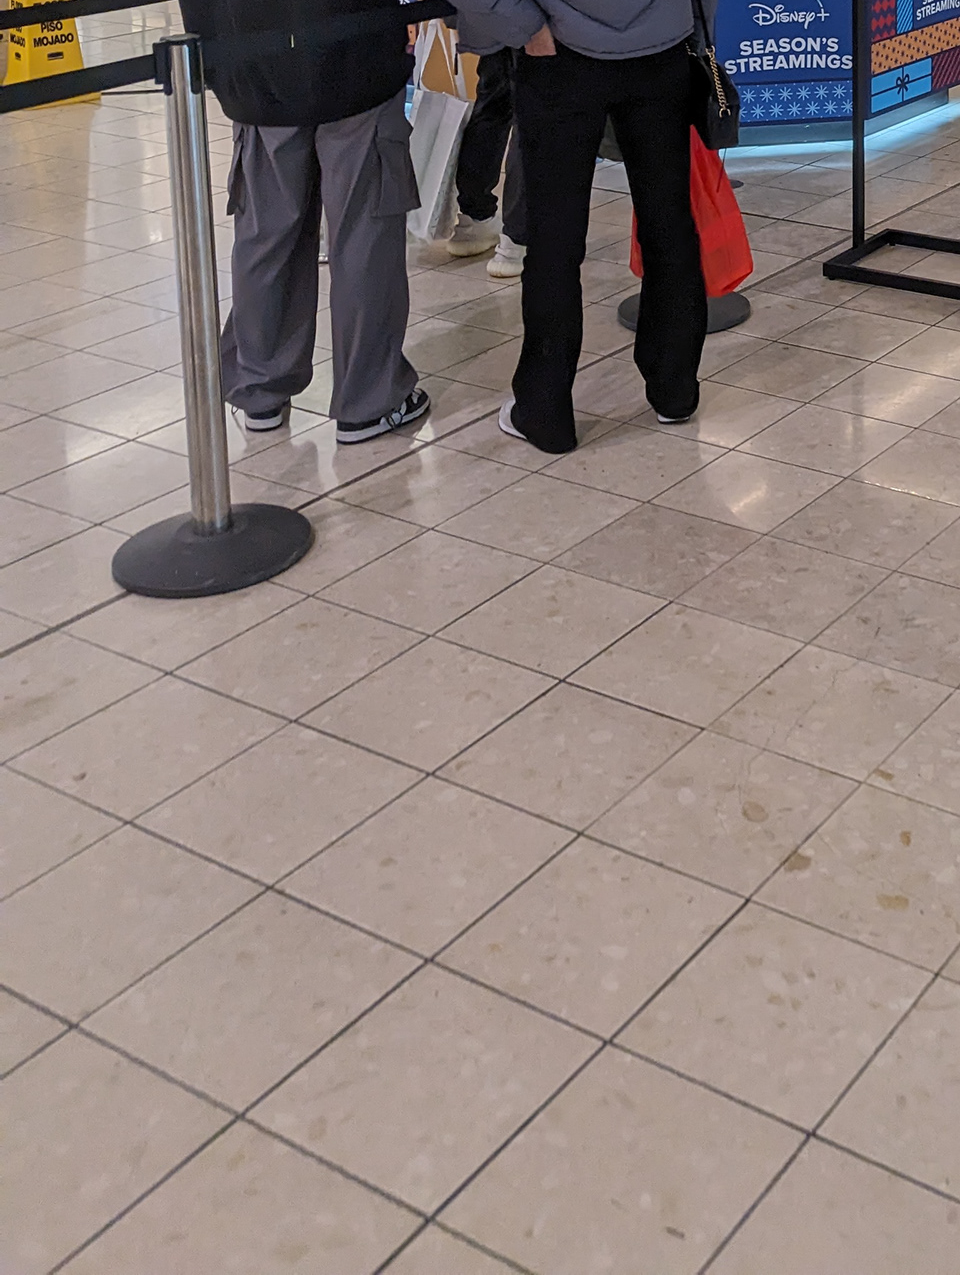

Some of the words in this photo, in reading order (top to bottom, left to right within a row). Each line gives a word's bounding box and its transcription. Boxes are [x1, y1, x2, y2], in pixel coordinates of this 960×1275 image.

[748, 2, 830, 29] Disney+
[40, 21, 64, 34] PISO
[33, 33, 75, 48] MOJADO
[739, 37, 840, 57] SEASON'S
[724, 53, 853, 75] STREAMINGS
